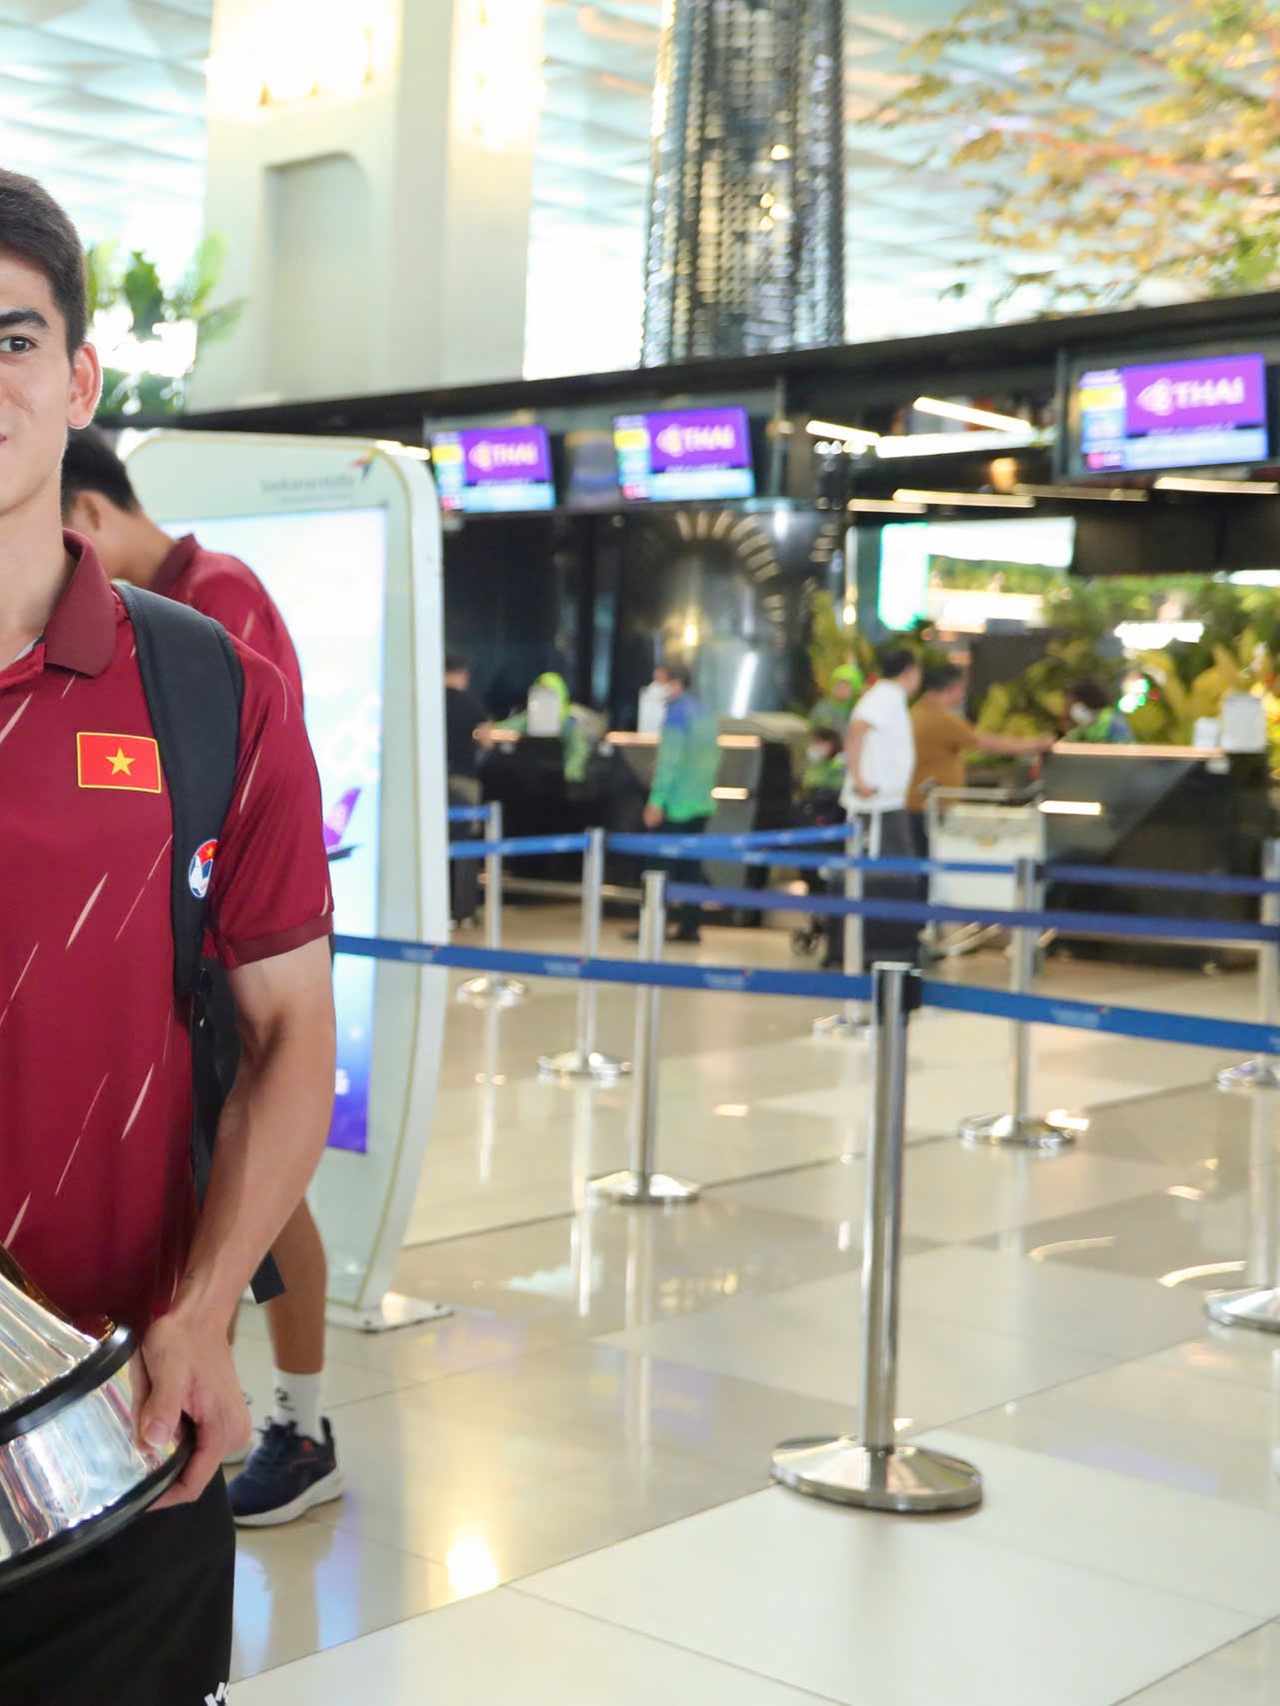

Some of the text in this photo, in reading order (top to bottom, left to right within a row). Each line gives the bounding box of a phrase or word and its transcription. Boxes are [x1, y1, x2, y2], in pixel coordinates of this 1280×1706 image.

[1173, 376, 1246, 409] THAI
[683, 424, 736, 452] THAI
[492, 441, 539, 467] THAI
